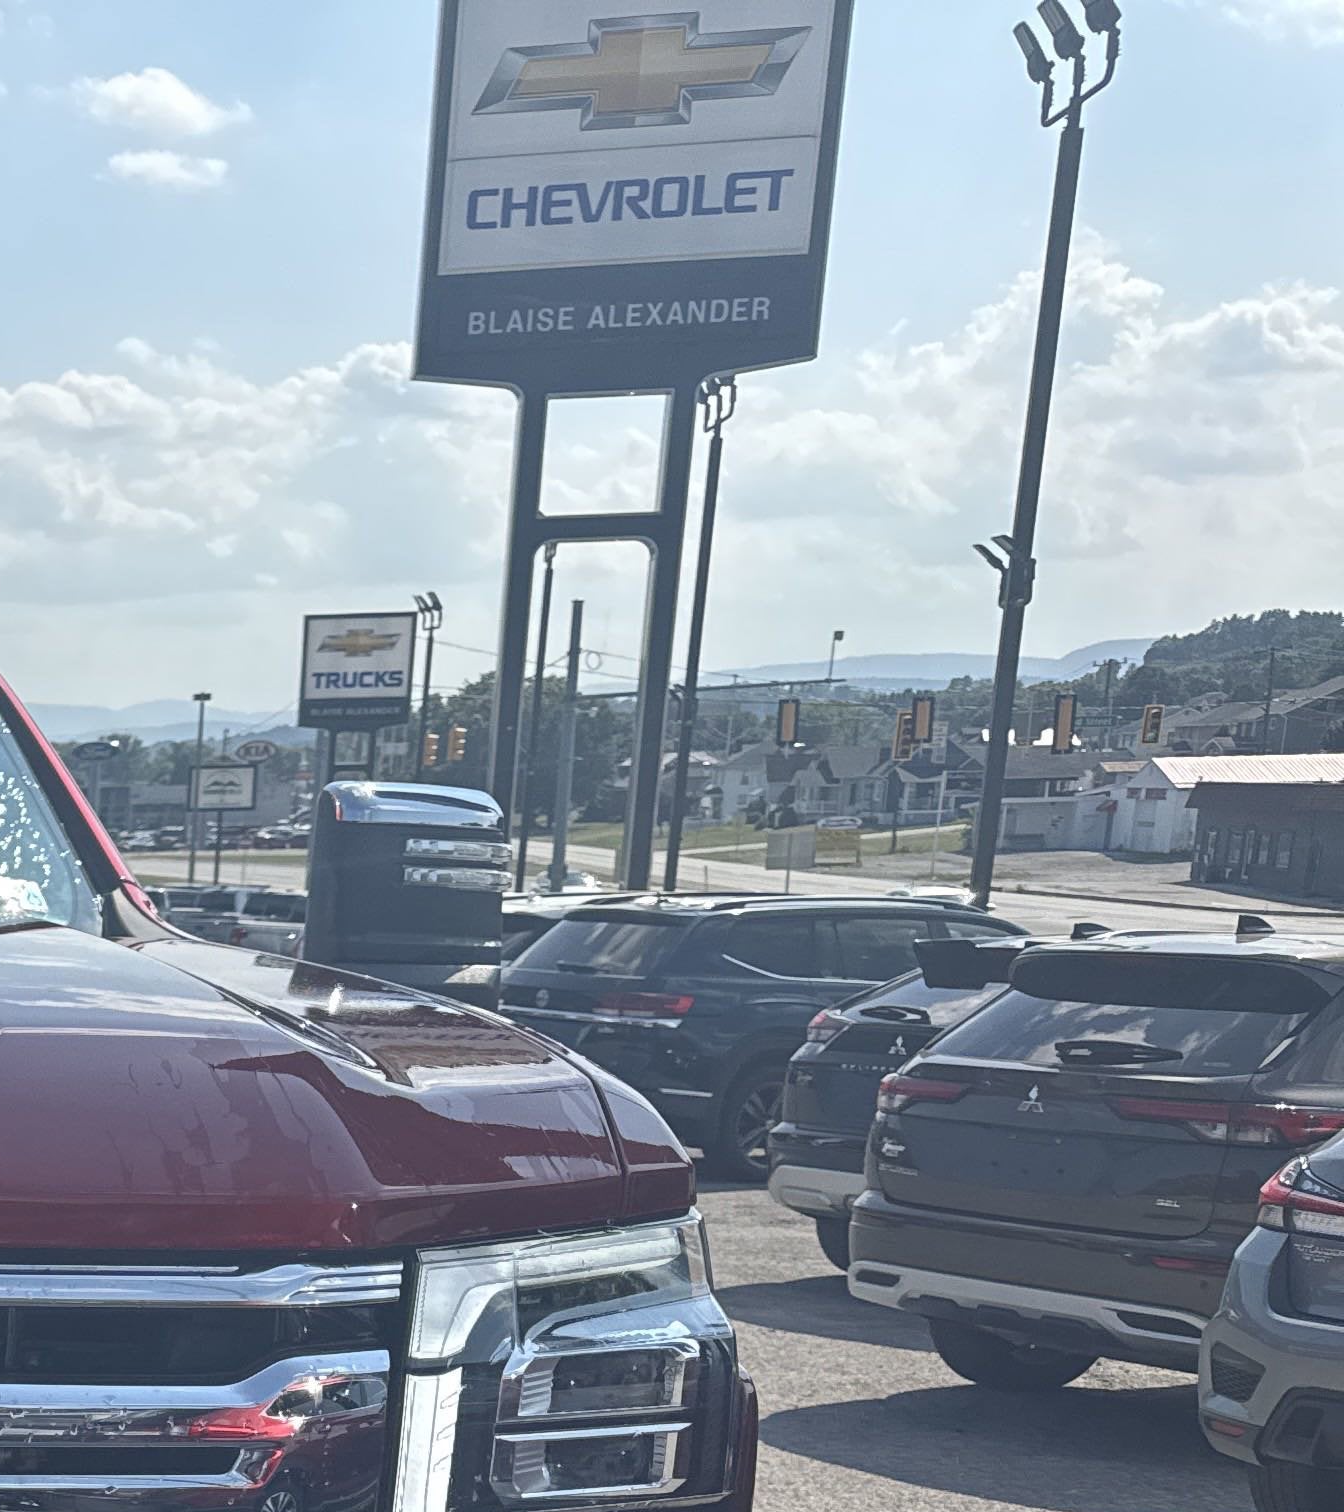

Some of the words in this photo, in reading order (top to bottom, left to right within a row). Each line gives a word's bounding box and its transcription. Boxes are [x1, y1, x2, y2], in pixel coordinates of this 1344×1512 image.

[466, 168, 795, 231] CHEVROLET
[466, 306, 576, 337] BLAISE
[585, 296, 771, 331] ALEXANDER
[312, 670, 404, 689] TRUCKS
